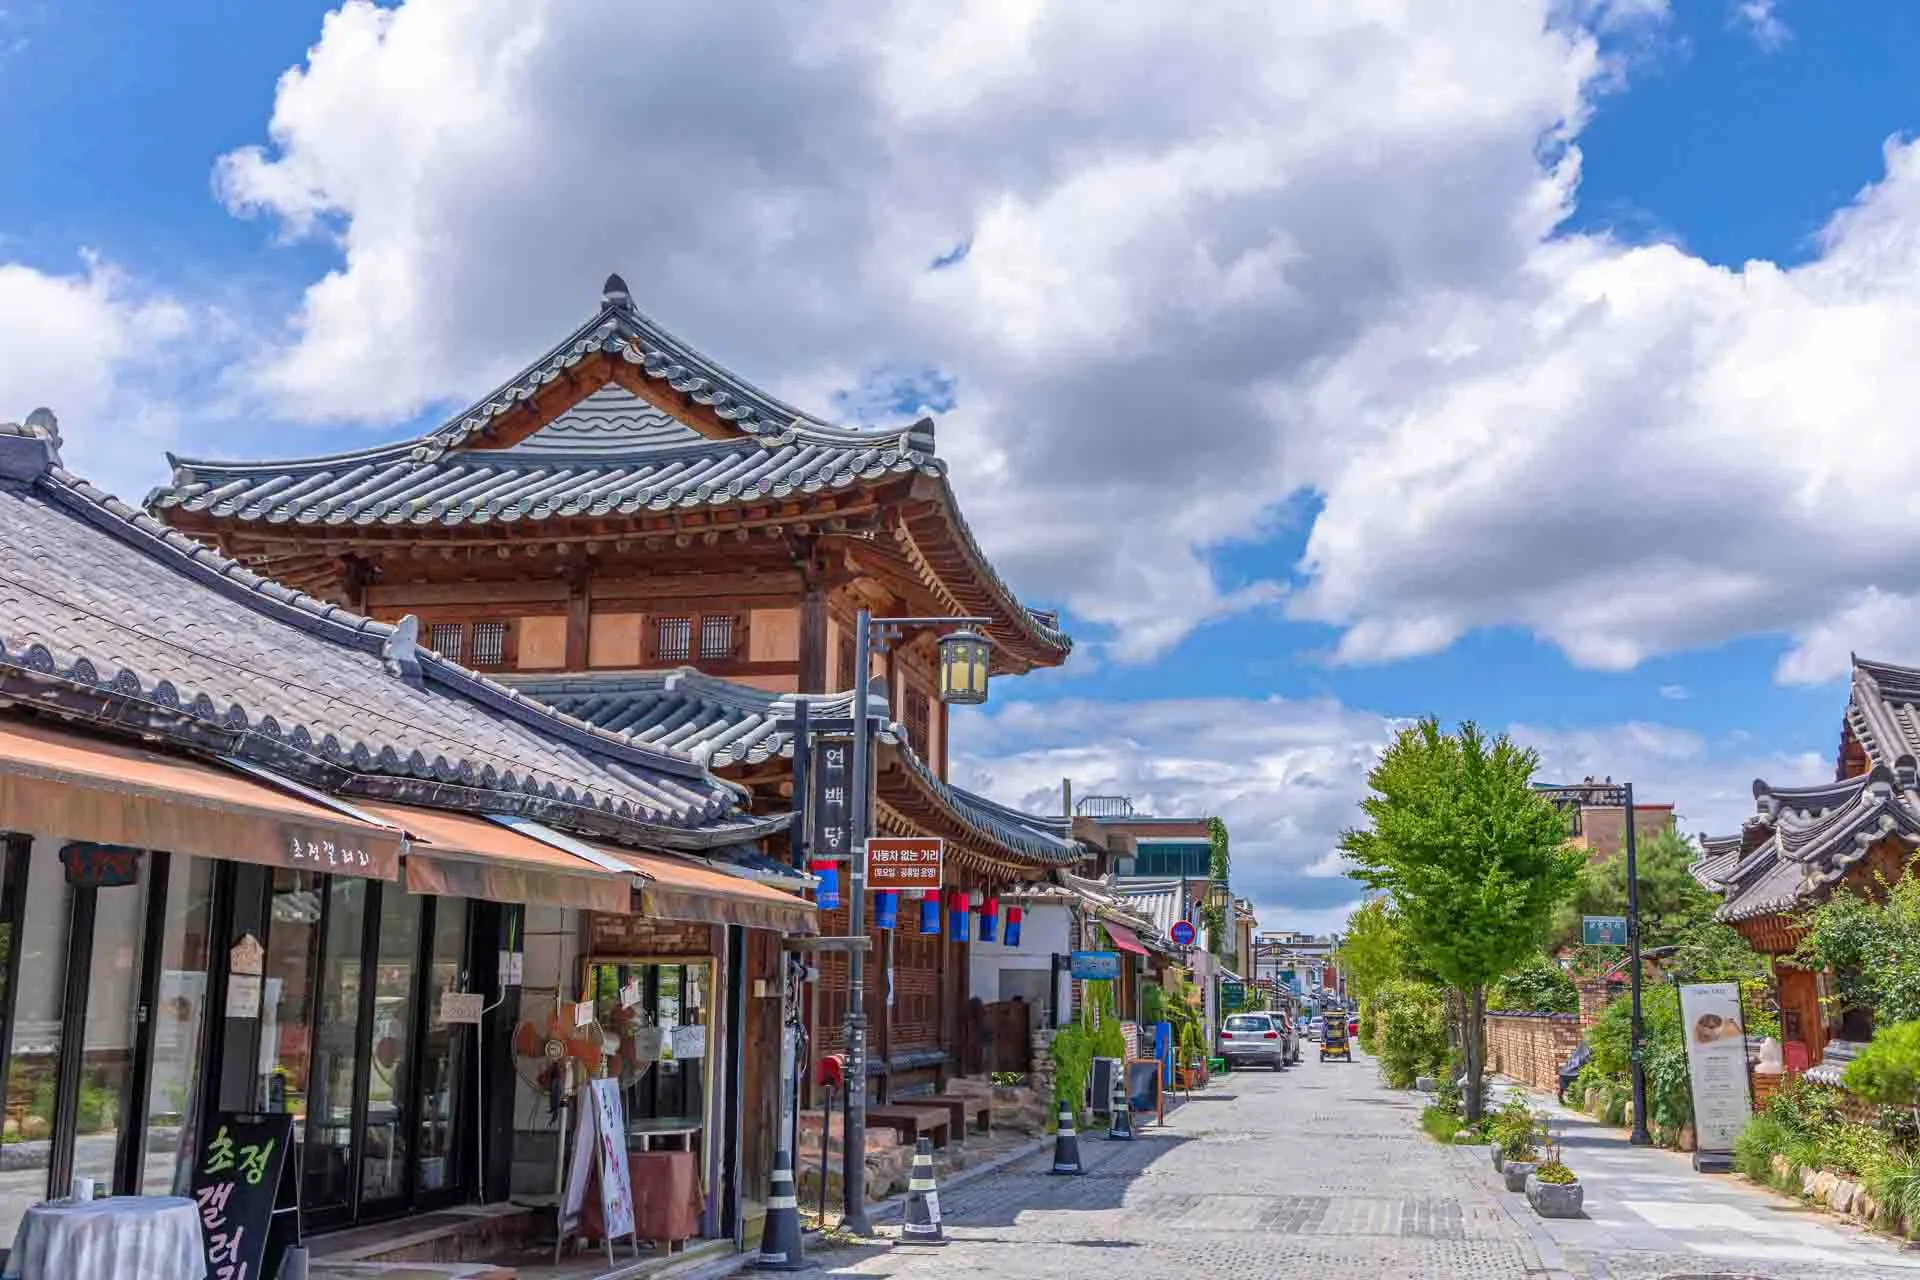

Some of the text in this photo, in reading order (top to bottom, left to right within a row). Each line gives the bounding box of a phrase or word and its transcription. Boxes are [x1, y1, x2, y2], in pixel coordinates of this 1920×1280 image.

[824, 747, 845, 847] 연백당
[872, 849, 939, 862] 자동차 없는 거리
[204, 1124, 275, 1185] 초정
